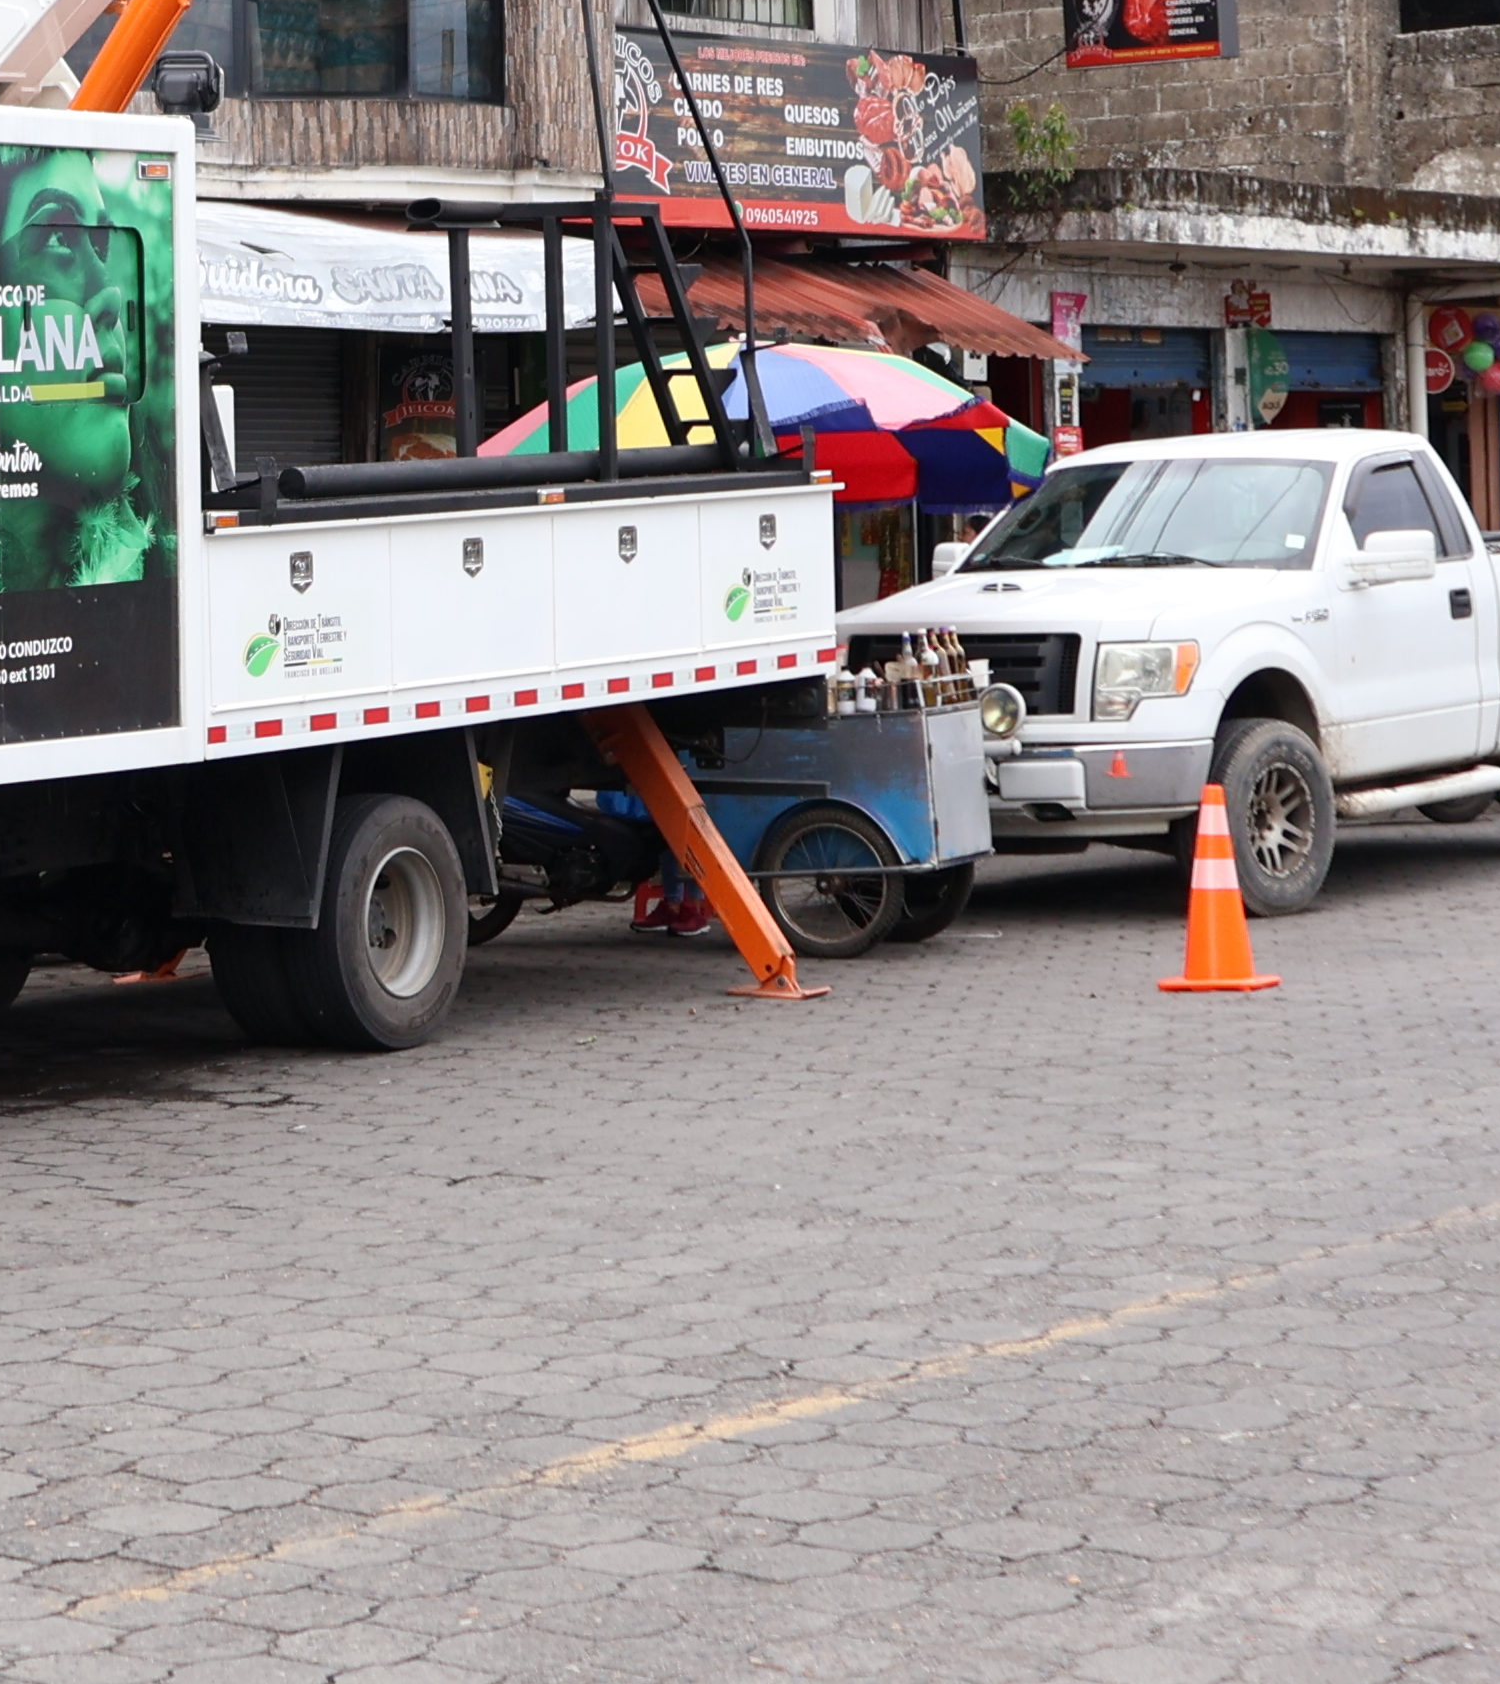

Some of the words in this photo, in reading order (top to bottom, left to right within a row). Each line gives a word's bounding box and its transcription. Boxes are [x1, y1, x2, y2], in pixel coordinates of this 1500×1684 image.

[734, 75, 753, 94] DE
[756, 77, 784, 97] RES
[784, 104, 840, 126] QUESOS
[677, 127, 725, 148] POLO
[785, 137, 865, 160] EMBUTIDOS
[749, 164, 770, 184] EN
[772, 165, 836, 189] GENERAL
[746, 207, 818, 225] 0960541925
[331, 263, 444, 305] SANTA
[27, 285, 45, 306] DE
[8, 636, 73, 659] CONDUZCO
[9, 668, 28, 684] ext
[29, 663, 56, 682] 1301
